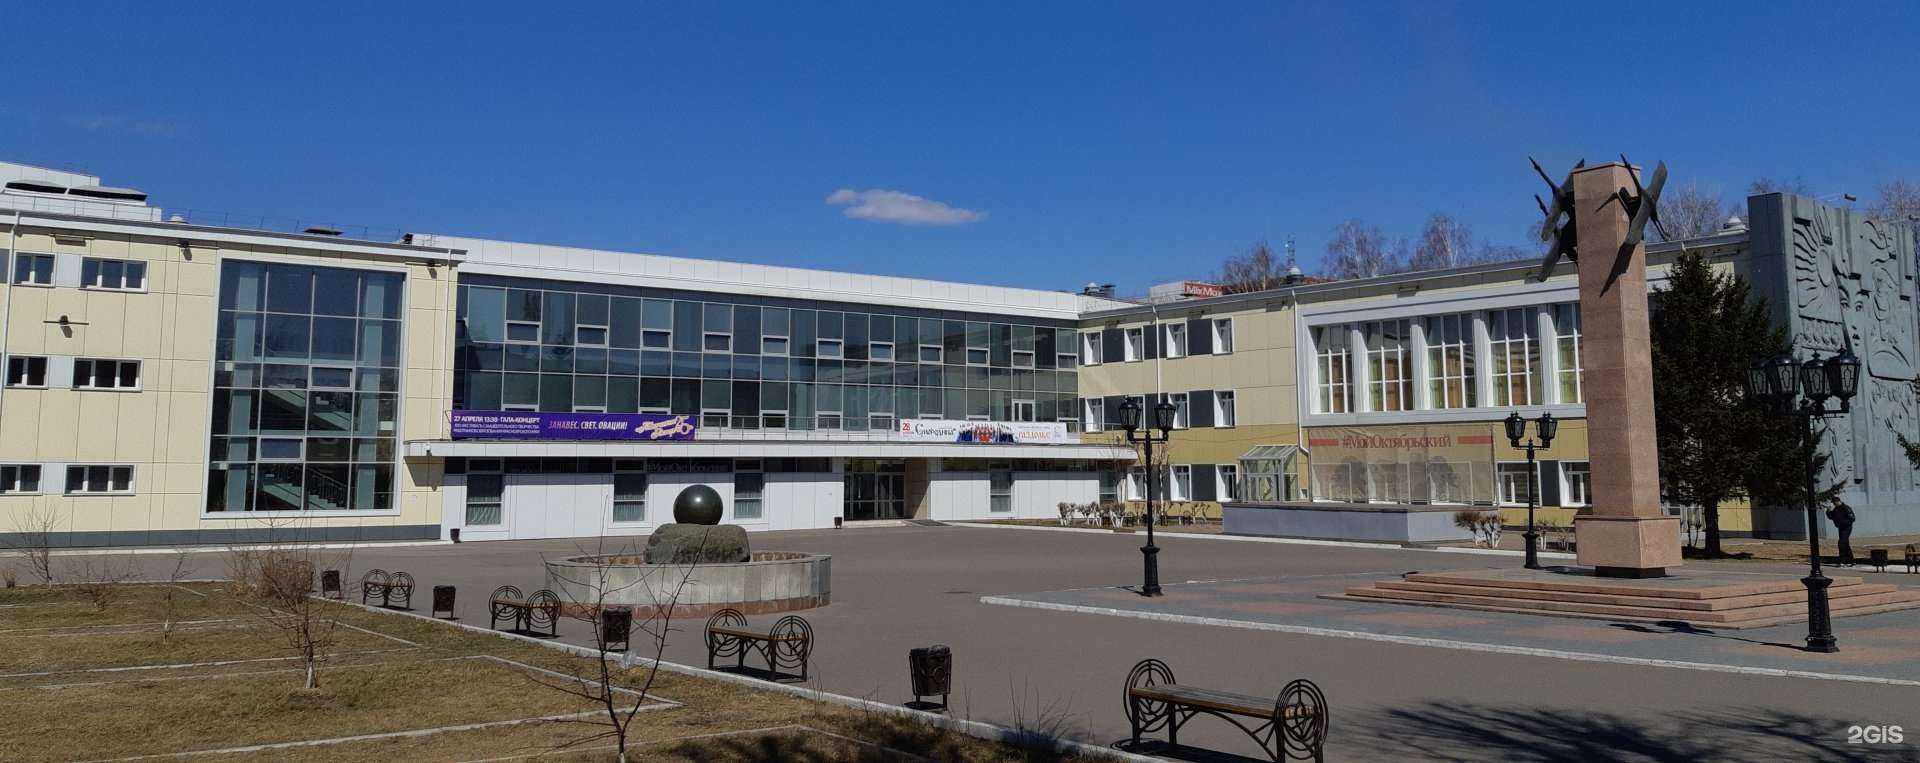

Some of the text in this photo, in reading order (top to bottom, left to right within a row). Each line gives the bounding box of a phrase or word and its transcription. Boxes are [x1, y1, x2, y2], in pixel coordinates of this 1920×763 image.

[548, 420, 579, 430] ЗАНАВЕС.
[580, 421, 596, 430] СВЕТ.
[598, 421, 628, 431] ОВАЦИИ!
[1342, 434, 1450, 450] #МойОктябрьский
